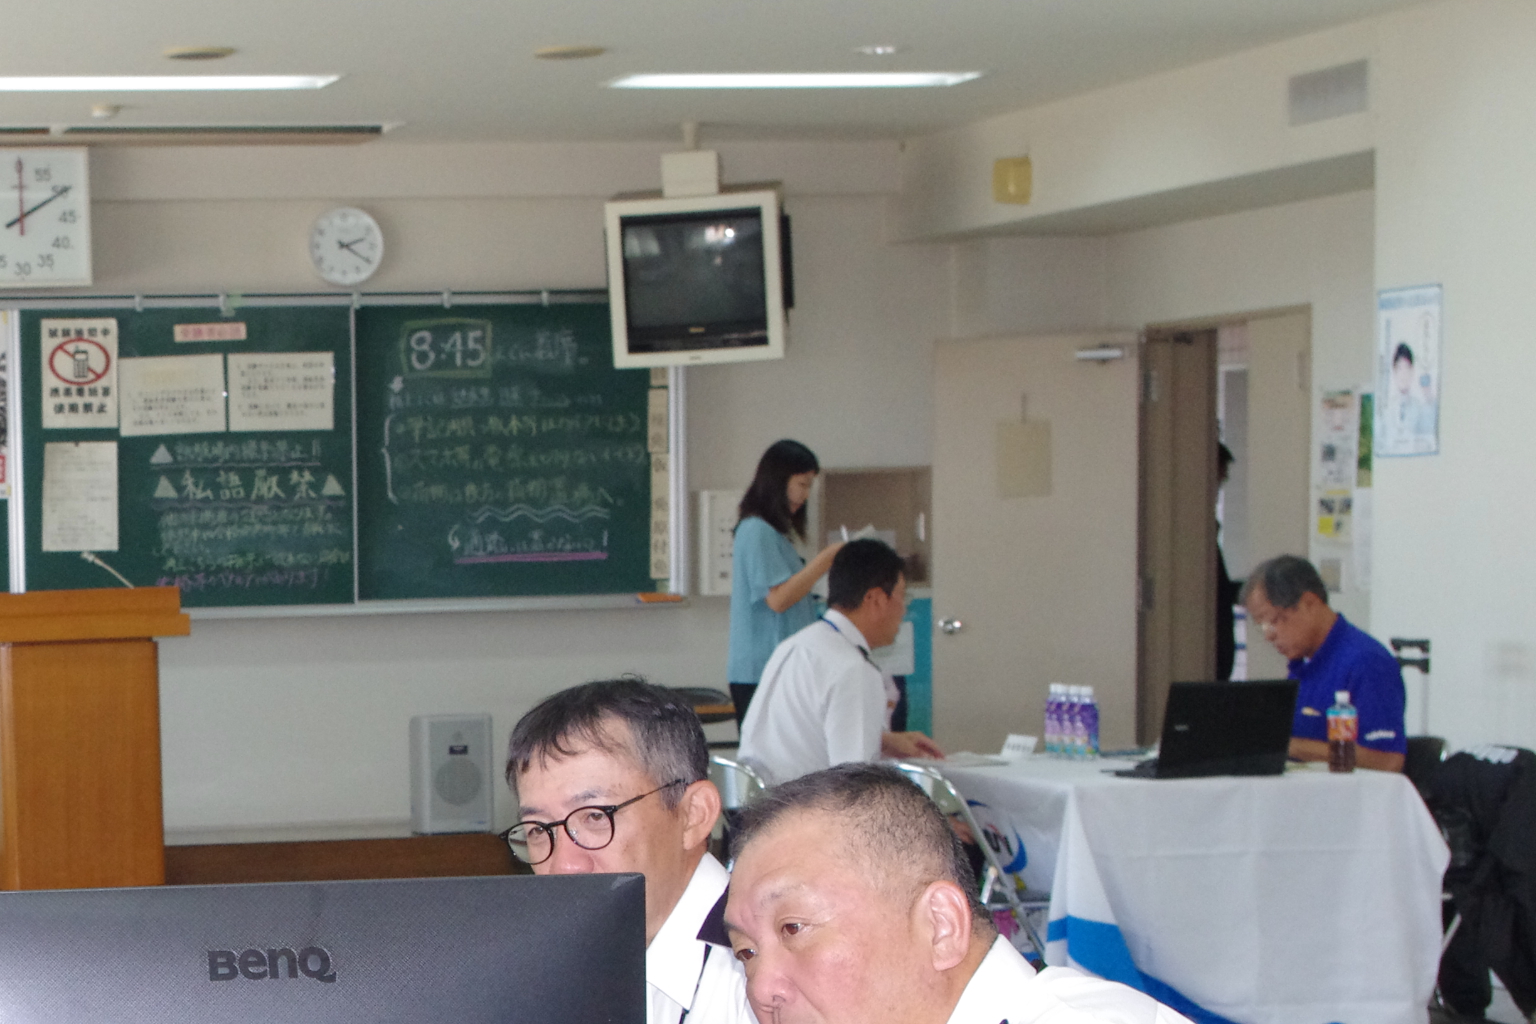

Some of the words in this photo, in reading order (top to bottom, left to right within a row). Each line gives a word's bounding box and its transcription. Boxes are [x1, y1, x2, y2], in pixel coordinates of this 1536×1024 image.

[34, 167, 52, 182] 55
[59, 209, 76, 224] 45
[52, 235, 70, 250] 40
[14, 261, 32, 276] 30
[37, 253, 54, 269] 35
[208, 946, 337, 984] BenQ
